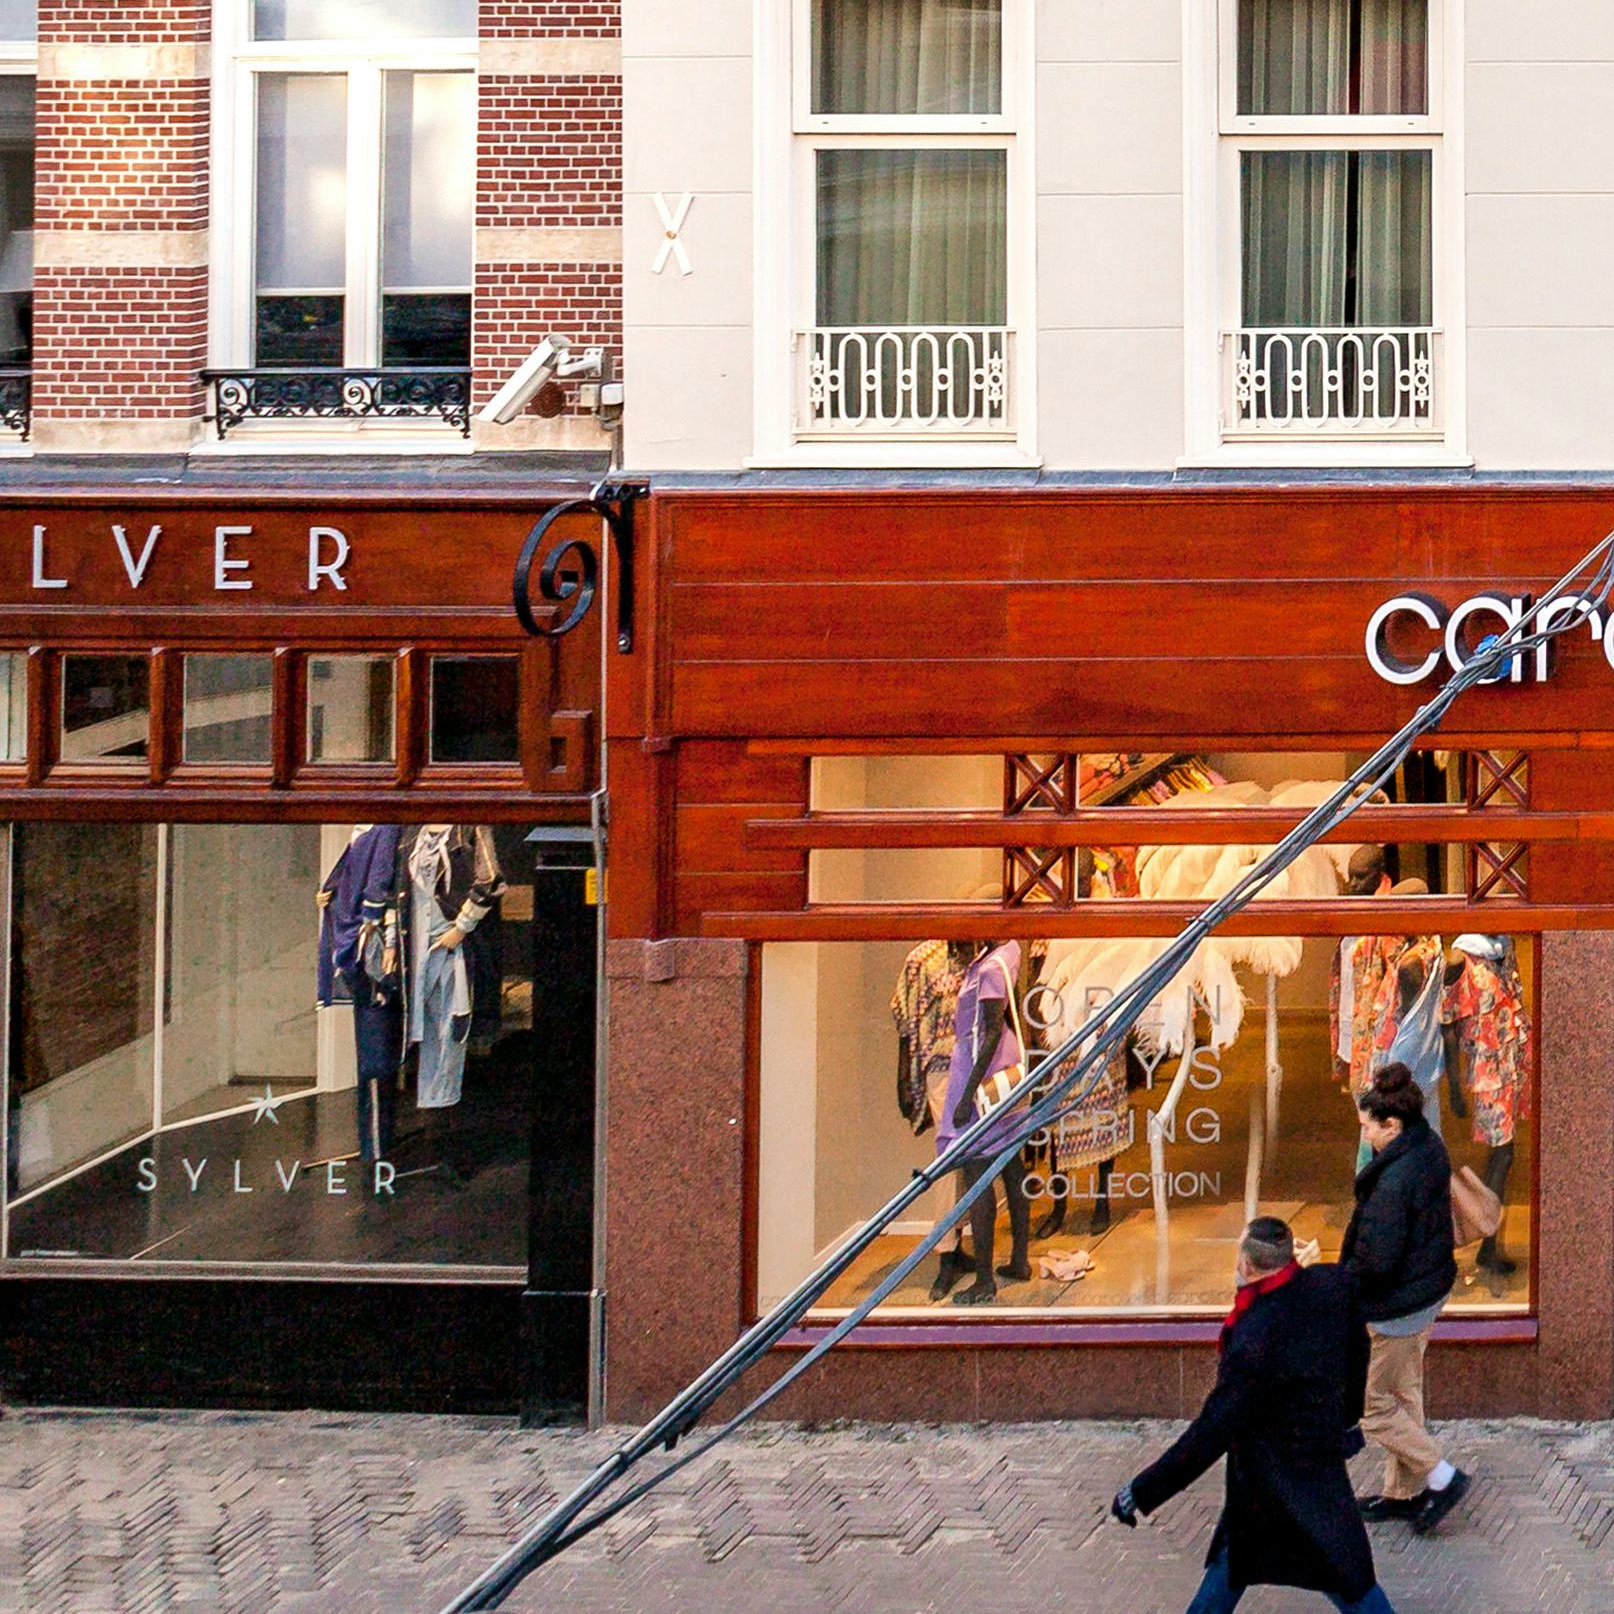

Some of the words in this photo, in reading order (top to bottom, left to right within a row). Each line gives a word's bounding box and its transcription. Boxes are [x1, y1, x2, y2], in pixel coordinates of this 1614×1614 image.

[32, 524, 350, 591] LVER
[136, 1157, 397, 1195] SYLVER
[1020, 1171, 1222, 1200] COLLECTION
